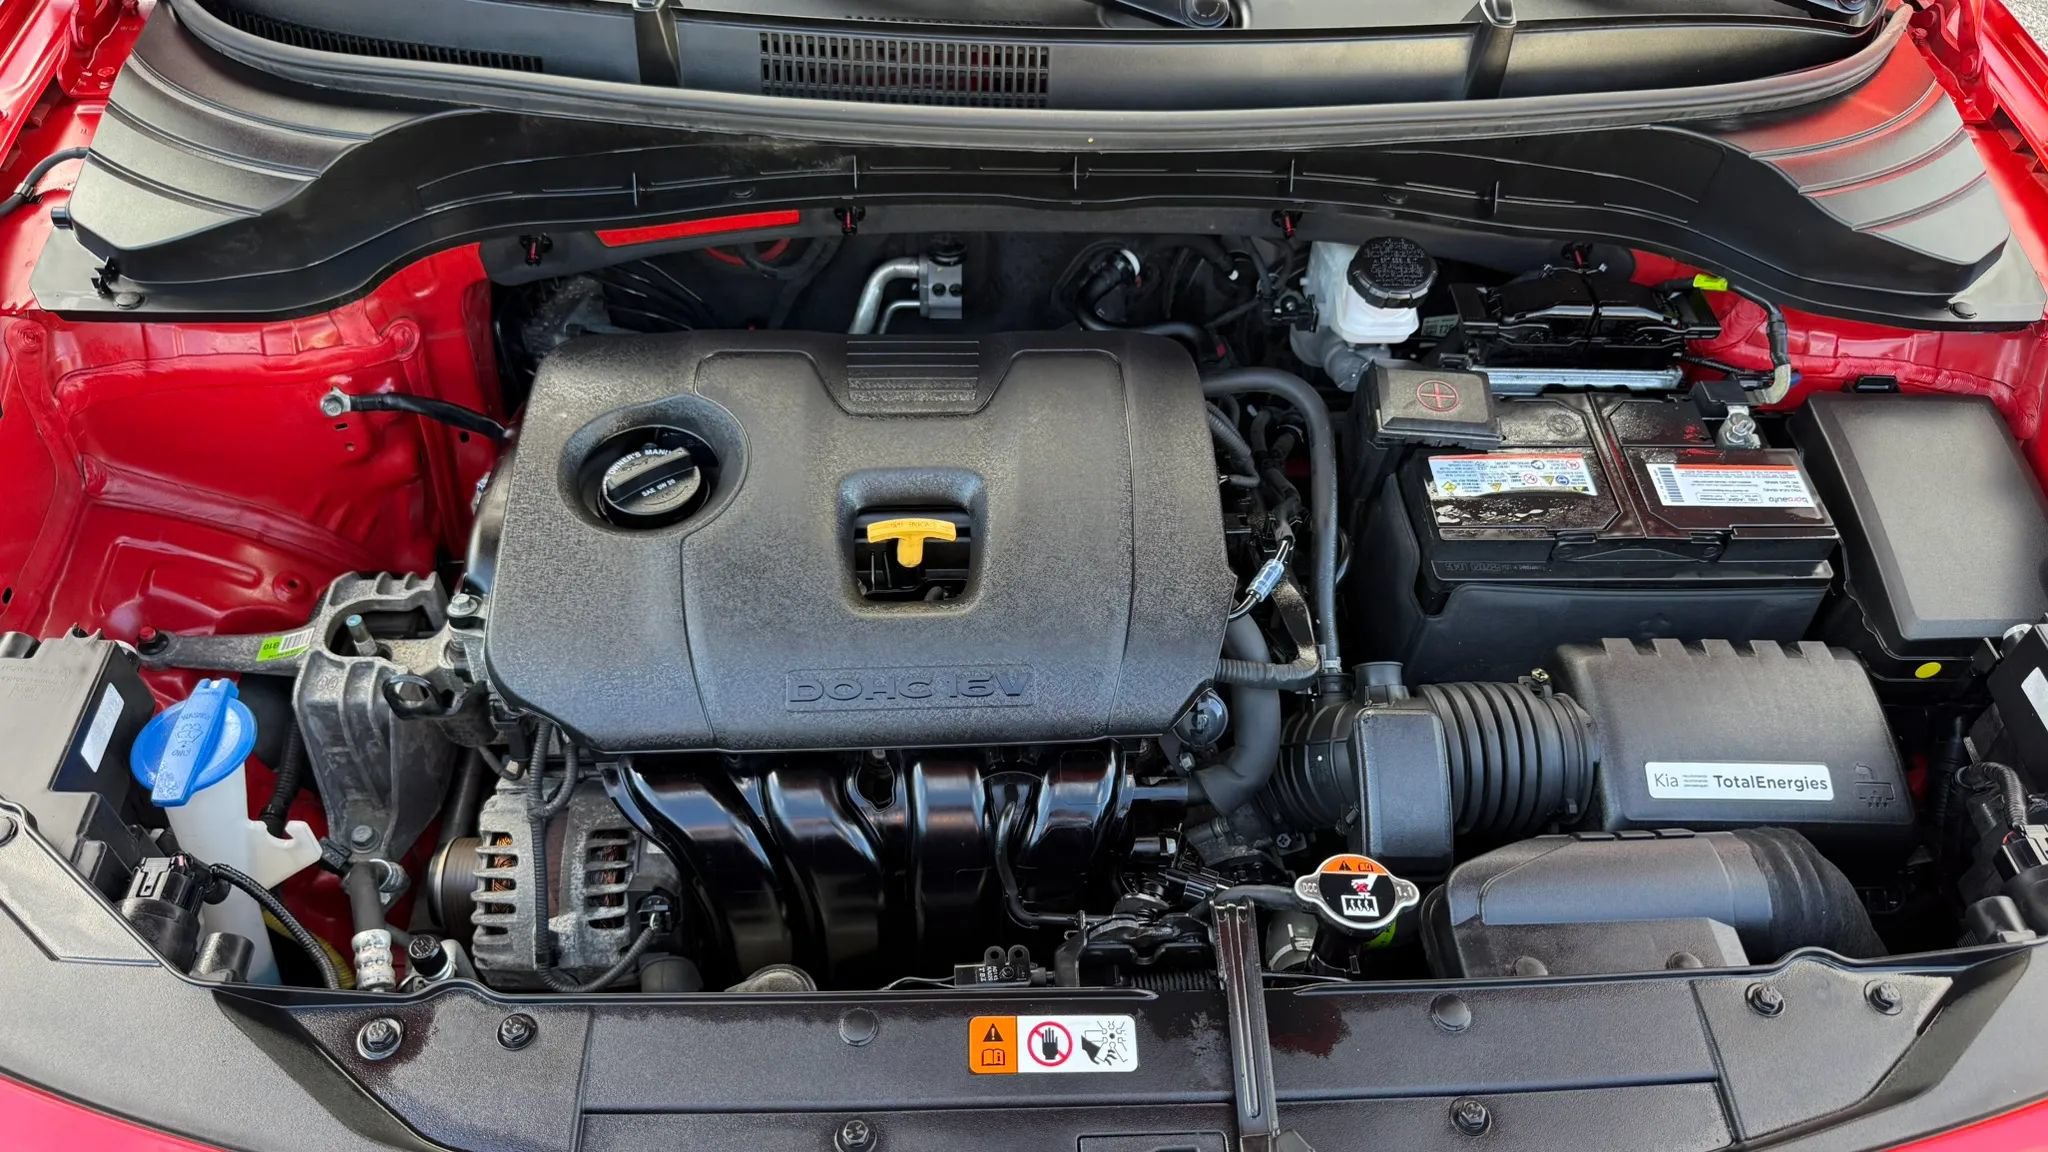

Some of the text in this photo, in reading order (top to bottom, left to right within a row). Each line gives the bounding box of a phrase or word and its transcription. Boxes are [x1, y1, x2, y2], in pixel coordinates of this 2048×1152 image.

[645, 448, 672, 457] MANU
[789, 671, 1031, 703] DOHC 16V
[1654, 773, 1680, 788] Kia
[1713, 774, 1828, 792] TotalEnergies
